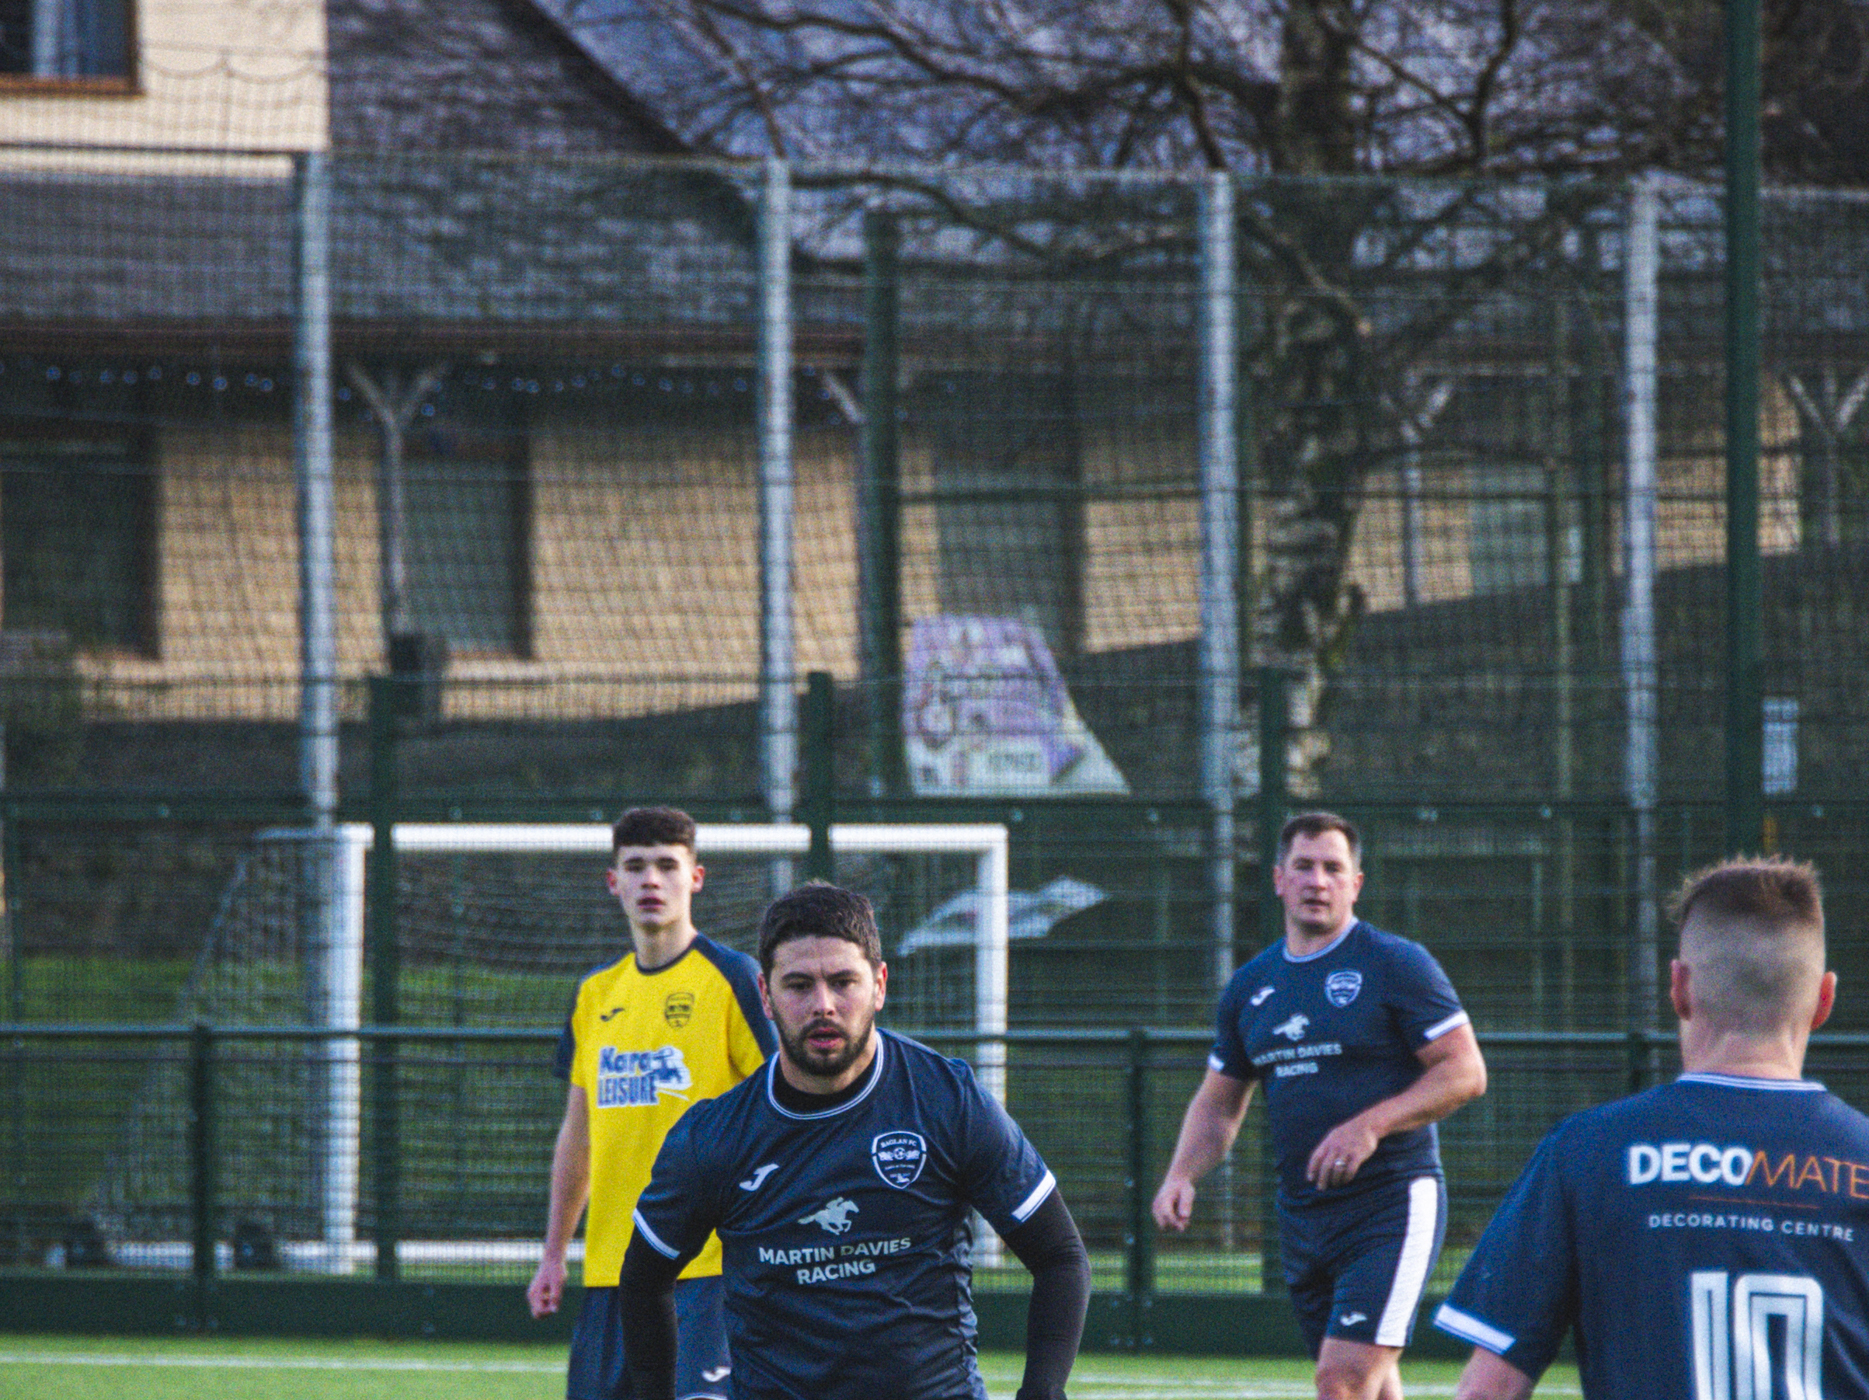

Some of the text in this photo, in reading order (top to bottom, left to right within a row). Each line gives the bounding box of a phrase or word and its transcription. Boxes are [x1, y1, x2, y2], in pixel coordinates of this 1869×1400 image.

[1648, 1213, 1854, 1243] DECORATING CENTRE
[758, 1237, 912, 1266] MARTIN DAVIES
[796, 1258, 876, 1285] RACING
